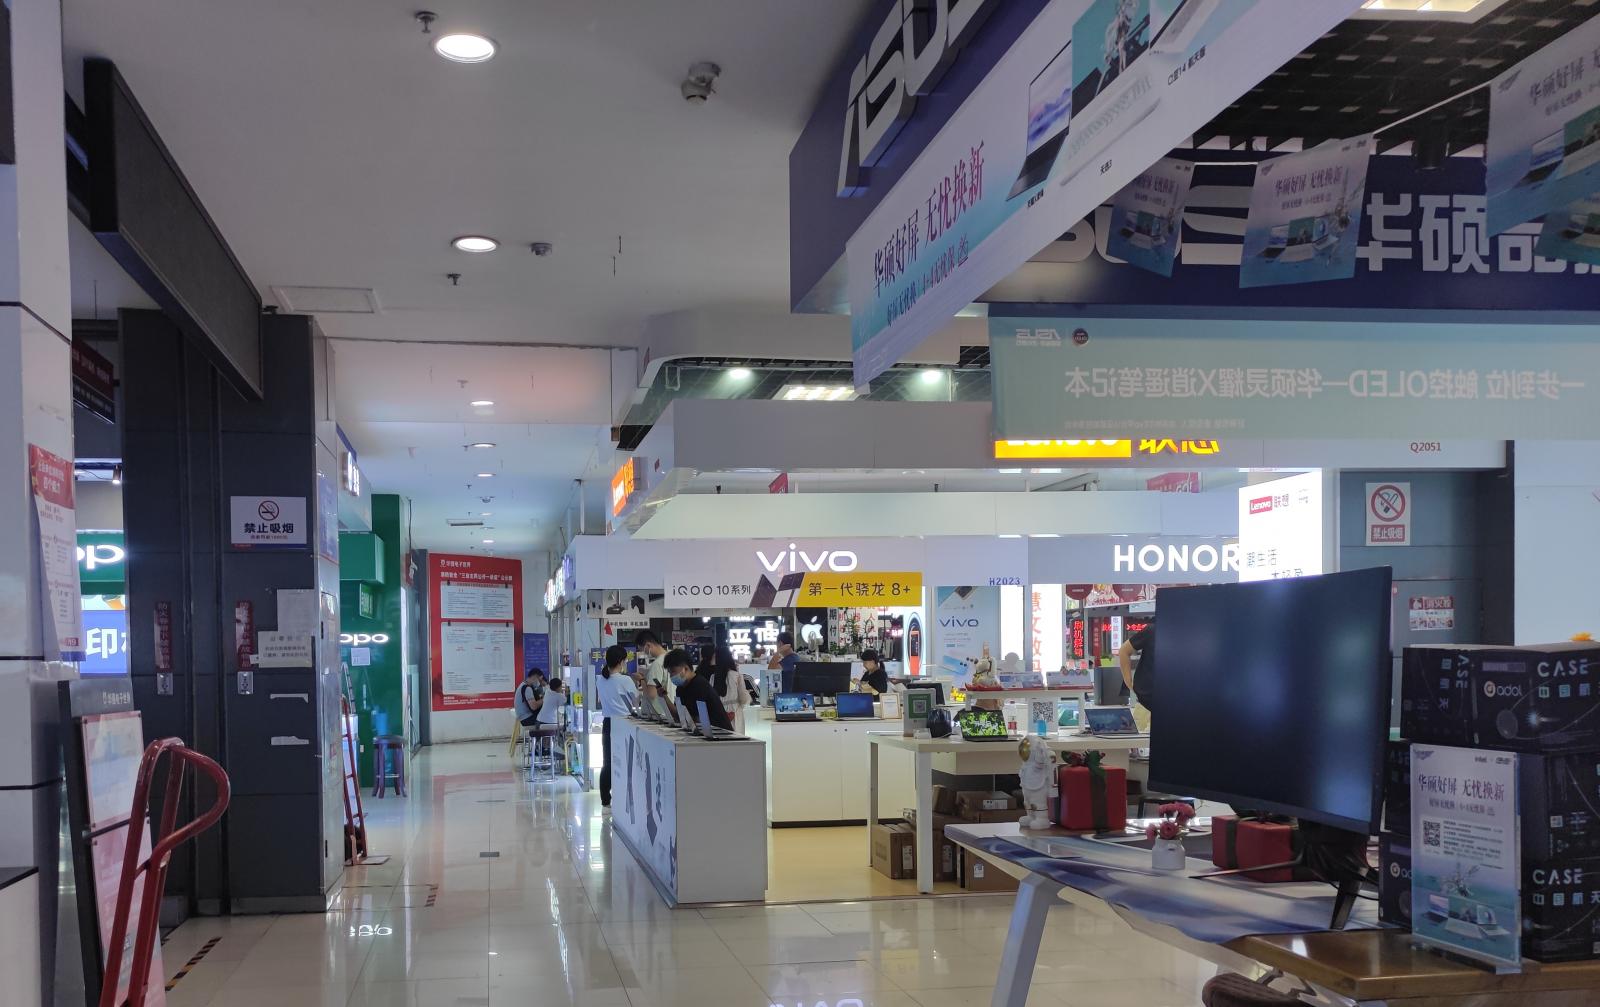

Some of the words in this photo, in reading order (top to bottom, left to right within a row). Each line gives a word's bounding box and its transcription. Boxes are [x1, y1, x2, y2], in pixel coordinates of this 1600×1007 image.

[1410, 442, 1442, 452] Q2051
[244, 522, 294, 534] 禁止吸烟
[1372, 527, 1404, 540] 禁止吸烟
[756, 543, 858, 571] vivo
[988, 576, 1021, 585] H2023
[672, 585, 713, 596] iQOO
[808, 583, 886, 597] 第一代骁龙
[891, 583, 911, 596] 8+
[938, 615, 980, 628] vivo
[1537, 658, 1589, 678] CASE
[1532, 867, 1584, 886] CASE
